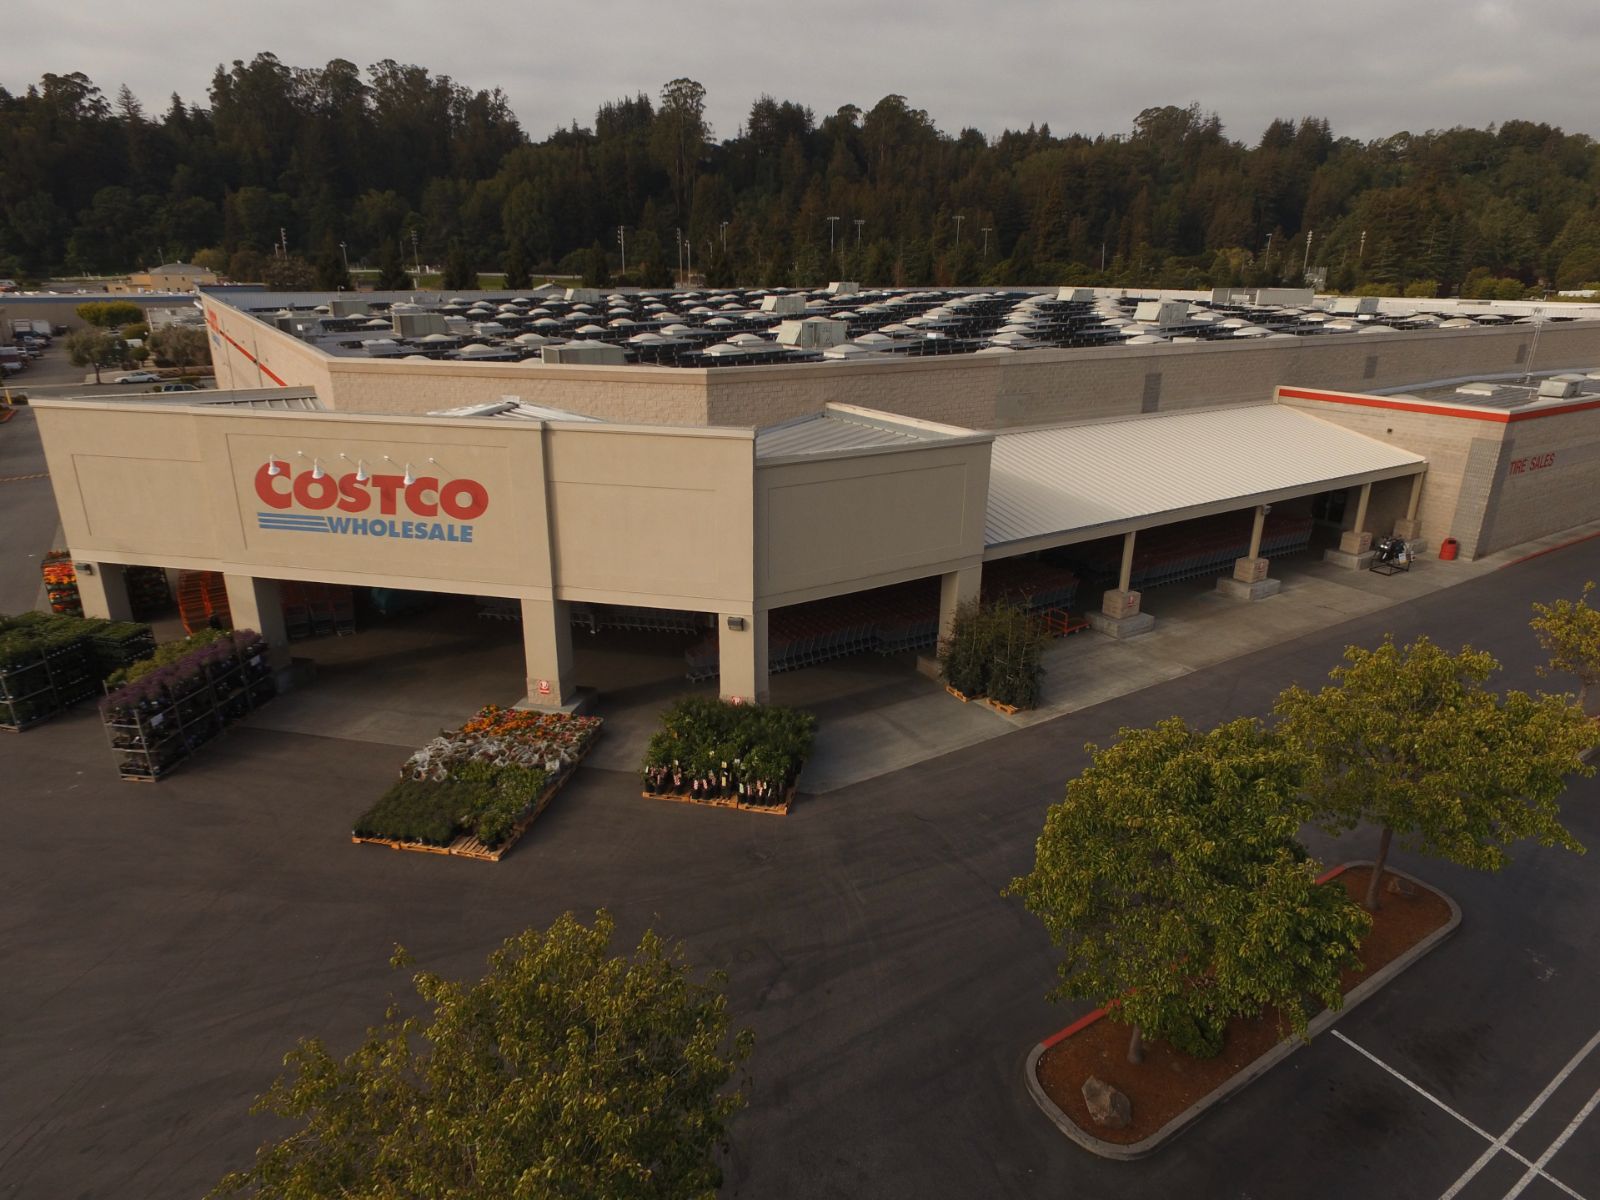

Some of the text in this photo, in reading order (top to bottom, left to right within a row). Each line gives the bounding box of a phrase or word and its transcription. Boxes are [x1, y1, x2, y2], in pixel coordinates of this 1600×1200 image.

[1509, 453, 1555, 475] TIRE SALES
[254, 460, 489, 520] COSTCO
[327, 516, 473, 543] WHOLESALE
